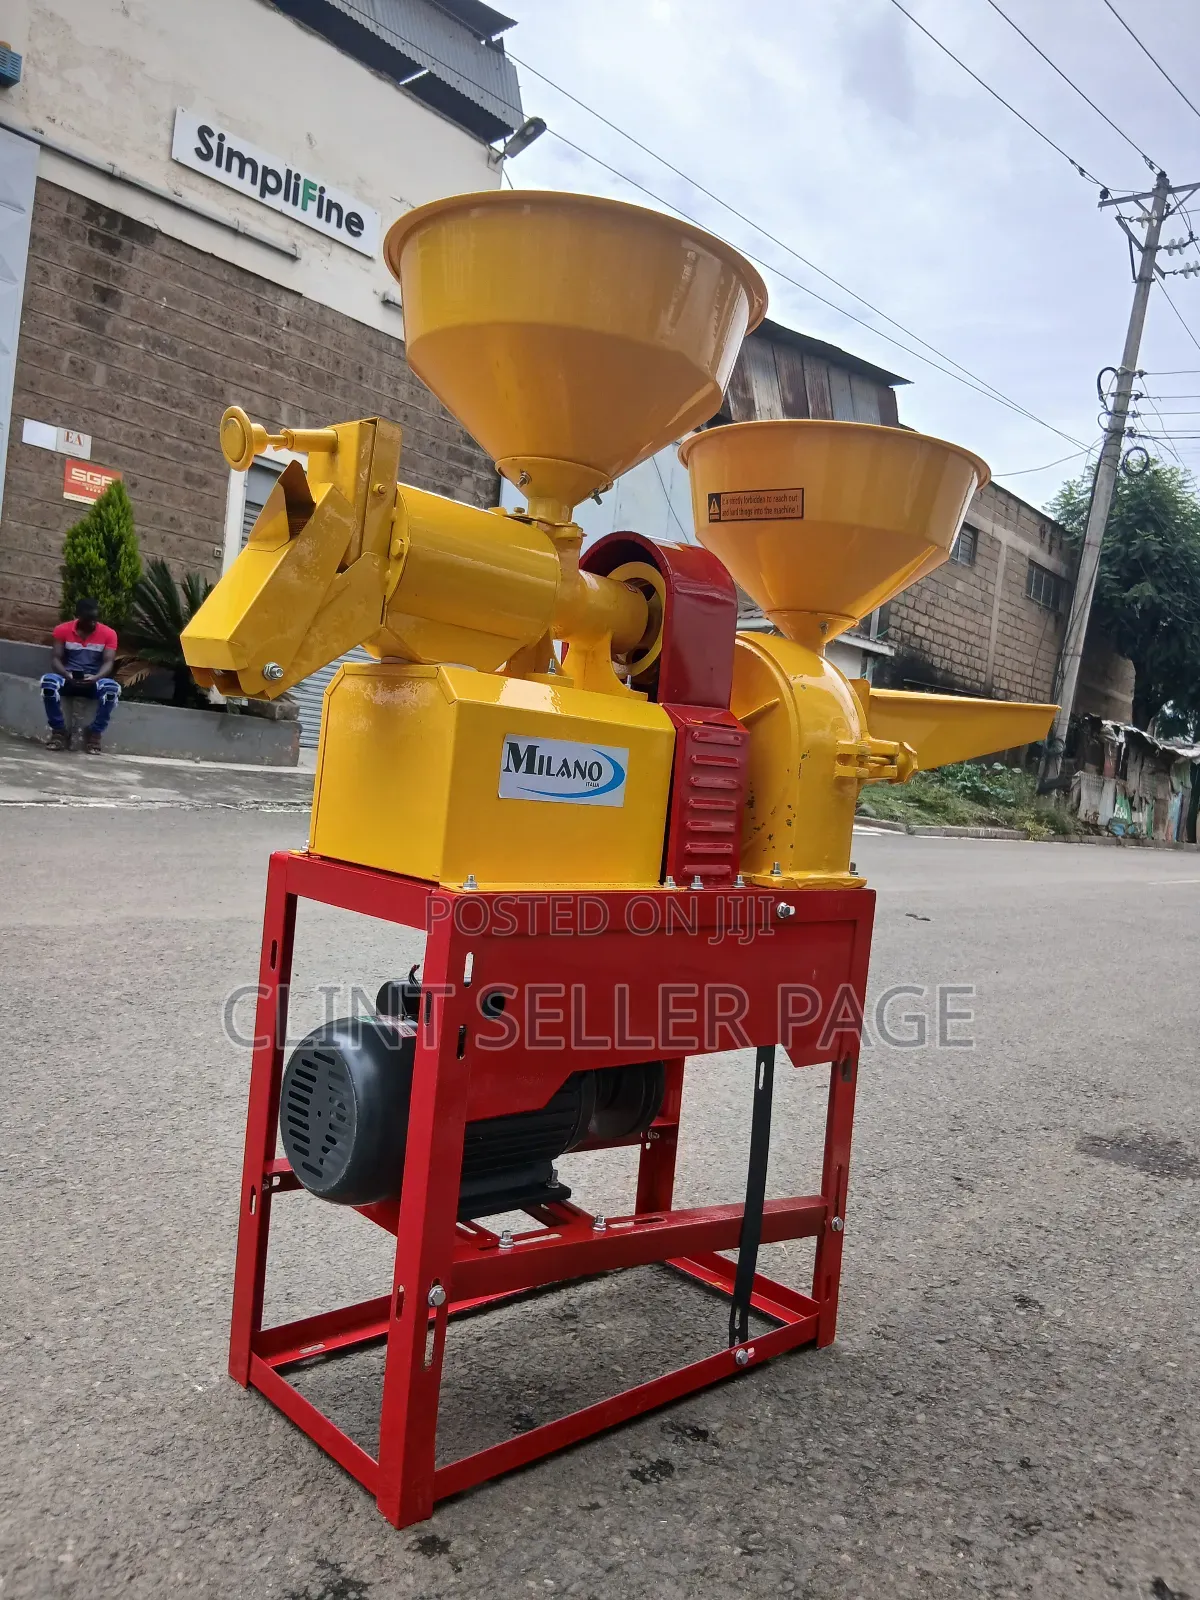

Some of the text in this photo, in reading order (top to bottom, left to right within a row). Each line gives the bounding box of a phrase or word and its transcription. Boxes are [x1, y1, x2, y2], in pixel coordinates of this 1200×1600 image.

[194, 125, 365, 238] SimpliFine
[739, 507, 753, 517] things
[754, 507, 763, 515] into
[764, 507, 772, 515] the
[774, 505, 795, 514] machine
[743, 496, 766, 504] forbidden
[773, 494, 788, 502] reach
[788, 494, 798, 502] out
[503, 741, 603, 782] MILANO
